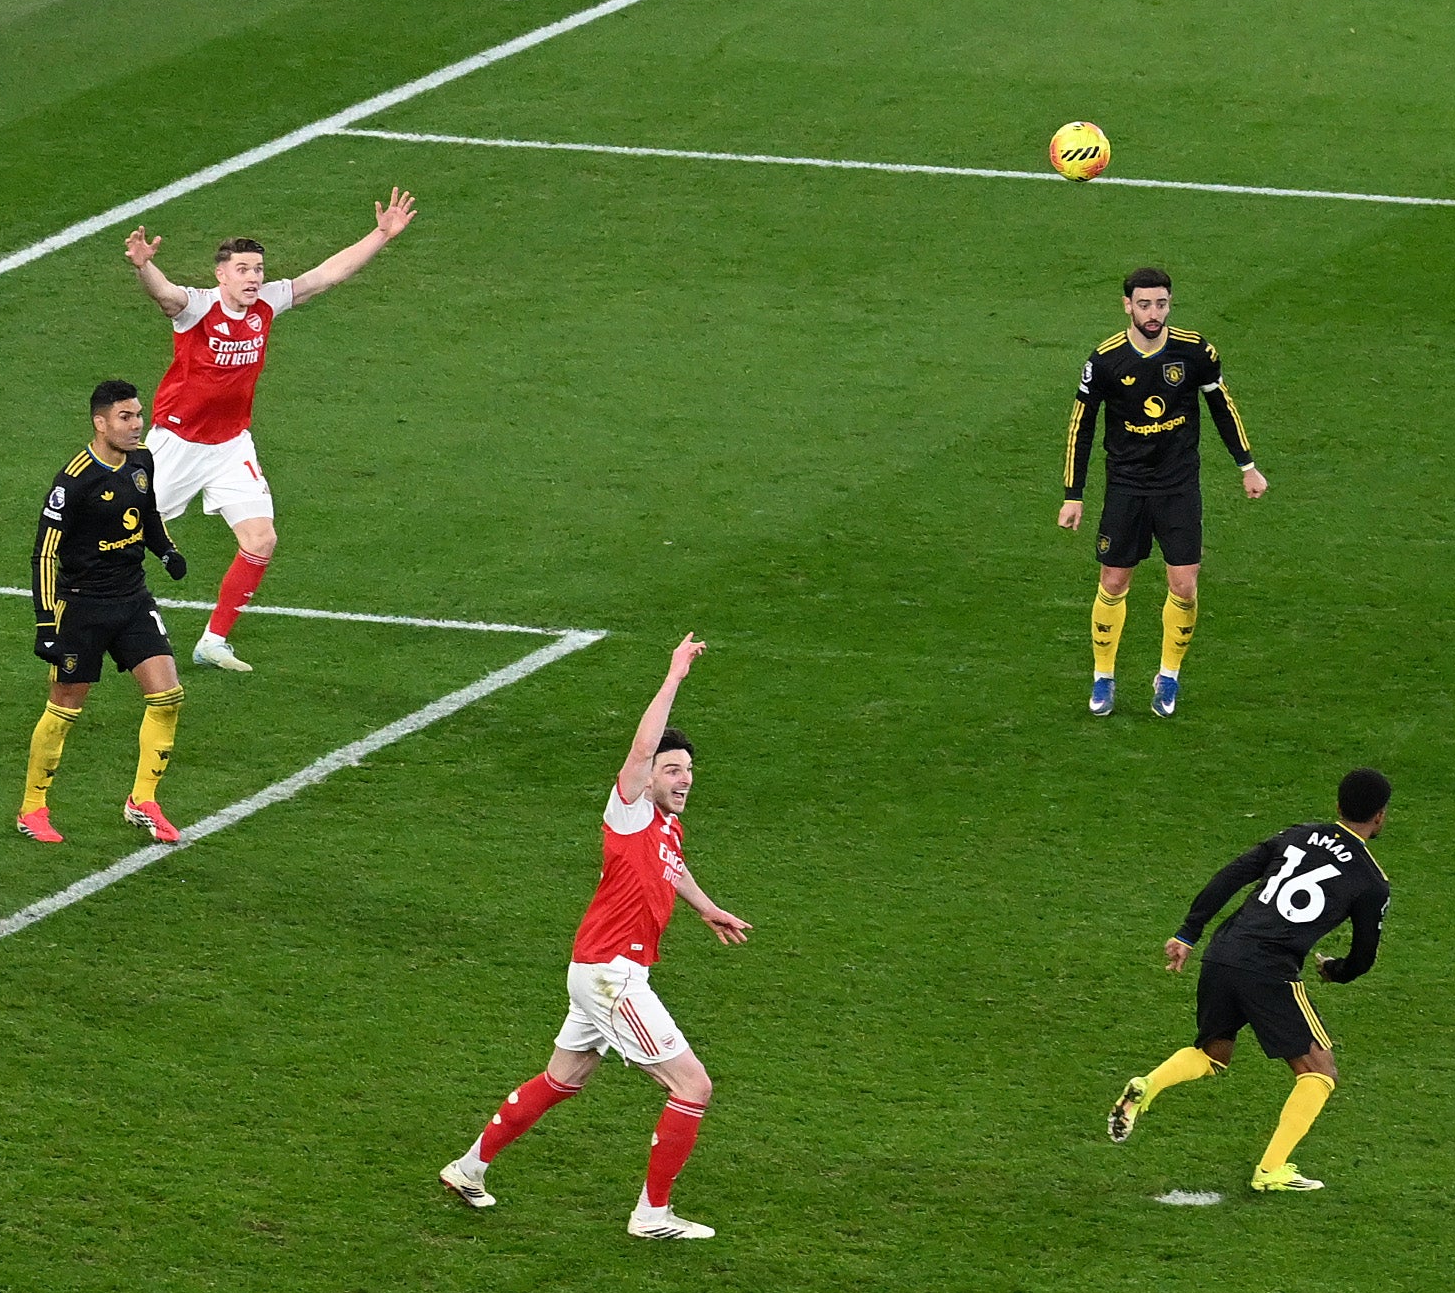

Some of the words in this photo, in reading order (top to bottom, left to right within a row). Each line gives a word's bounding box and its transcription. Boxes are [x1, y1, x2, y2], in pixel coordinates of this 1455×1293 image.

[1124, 414, 1186, 436] Snapdragon
[1307, 831, 1353, 863] AMAD
[1257, 844, 1342, 924] 16
